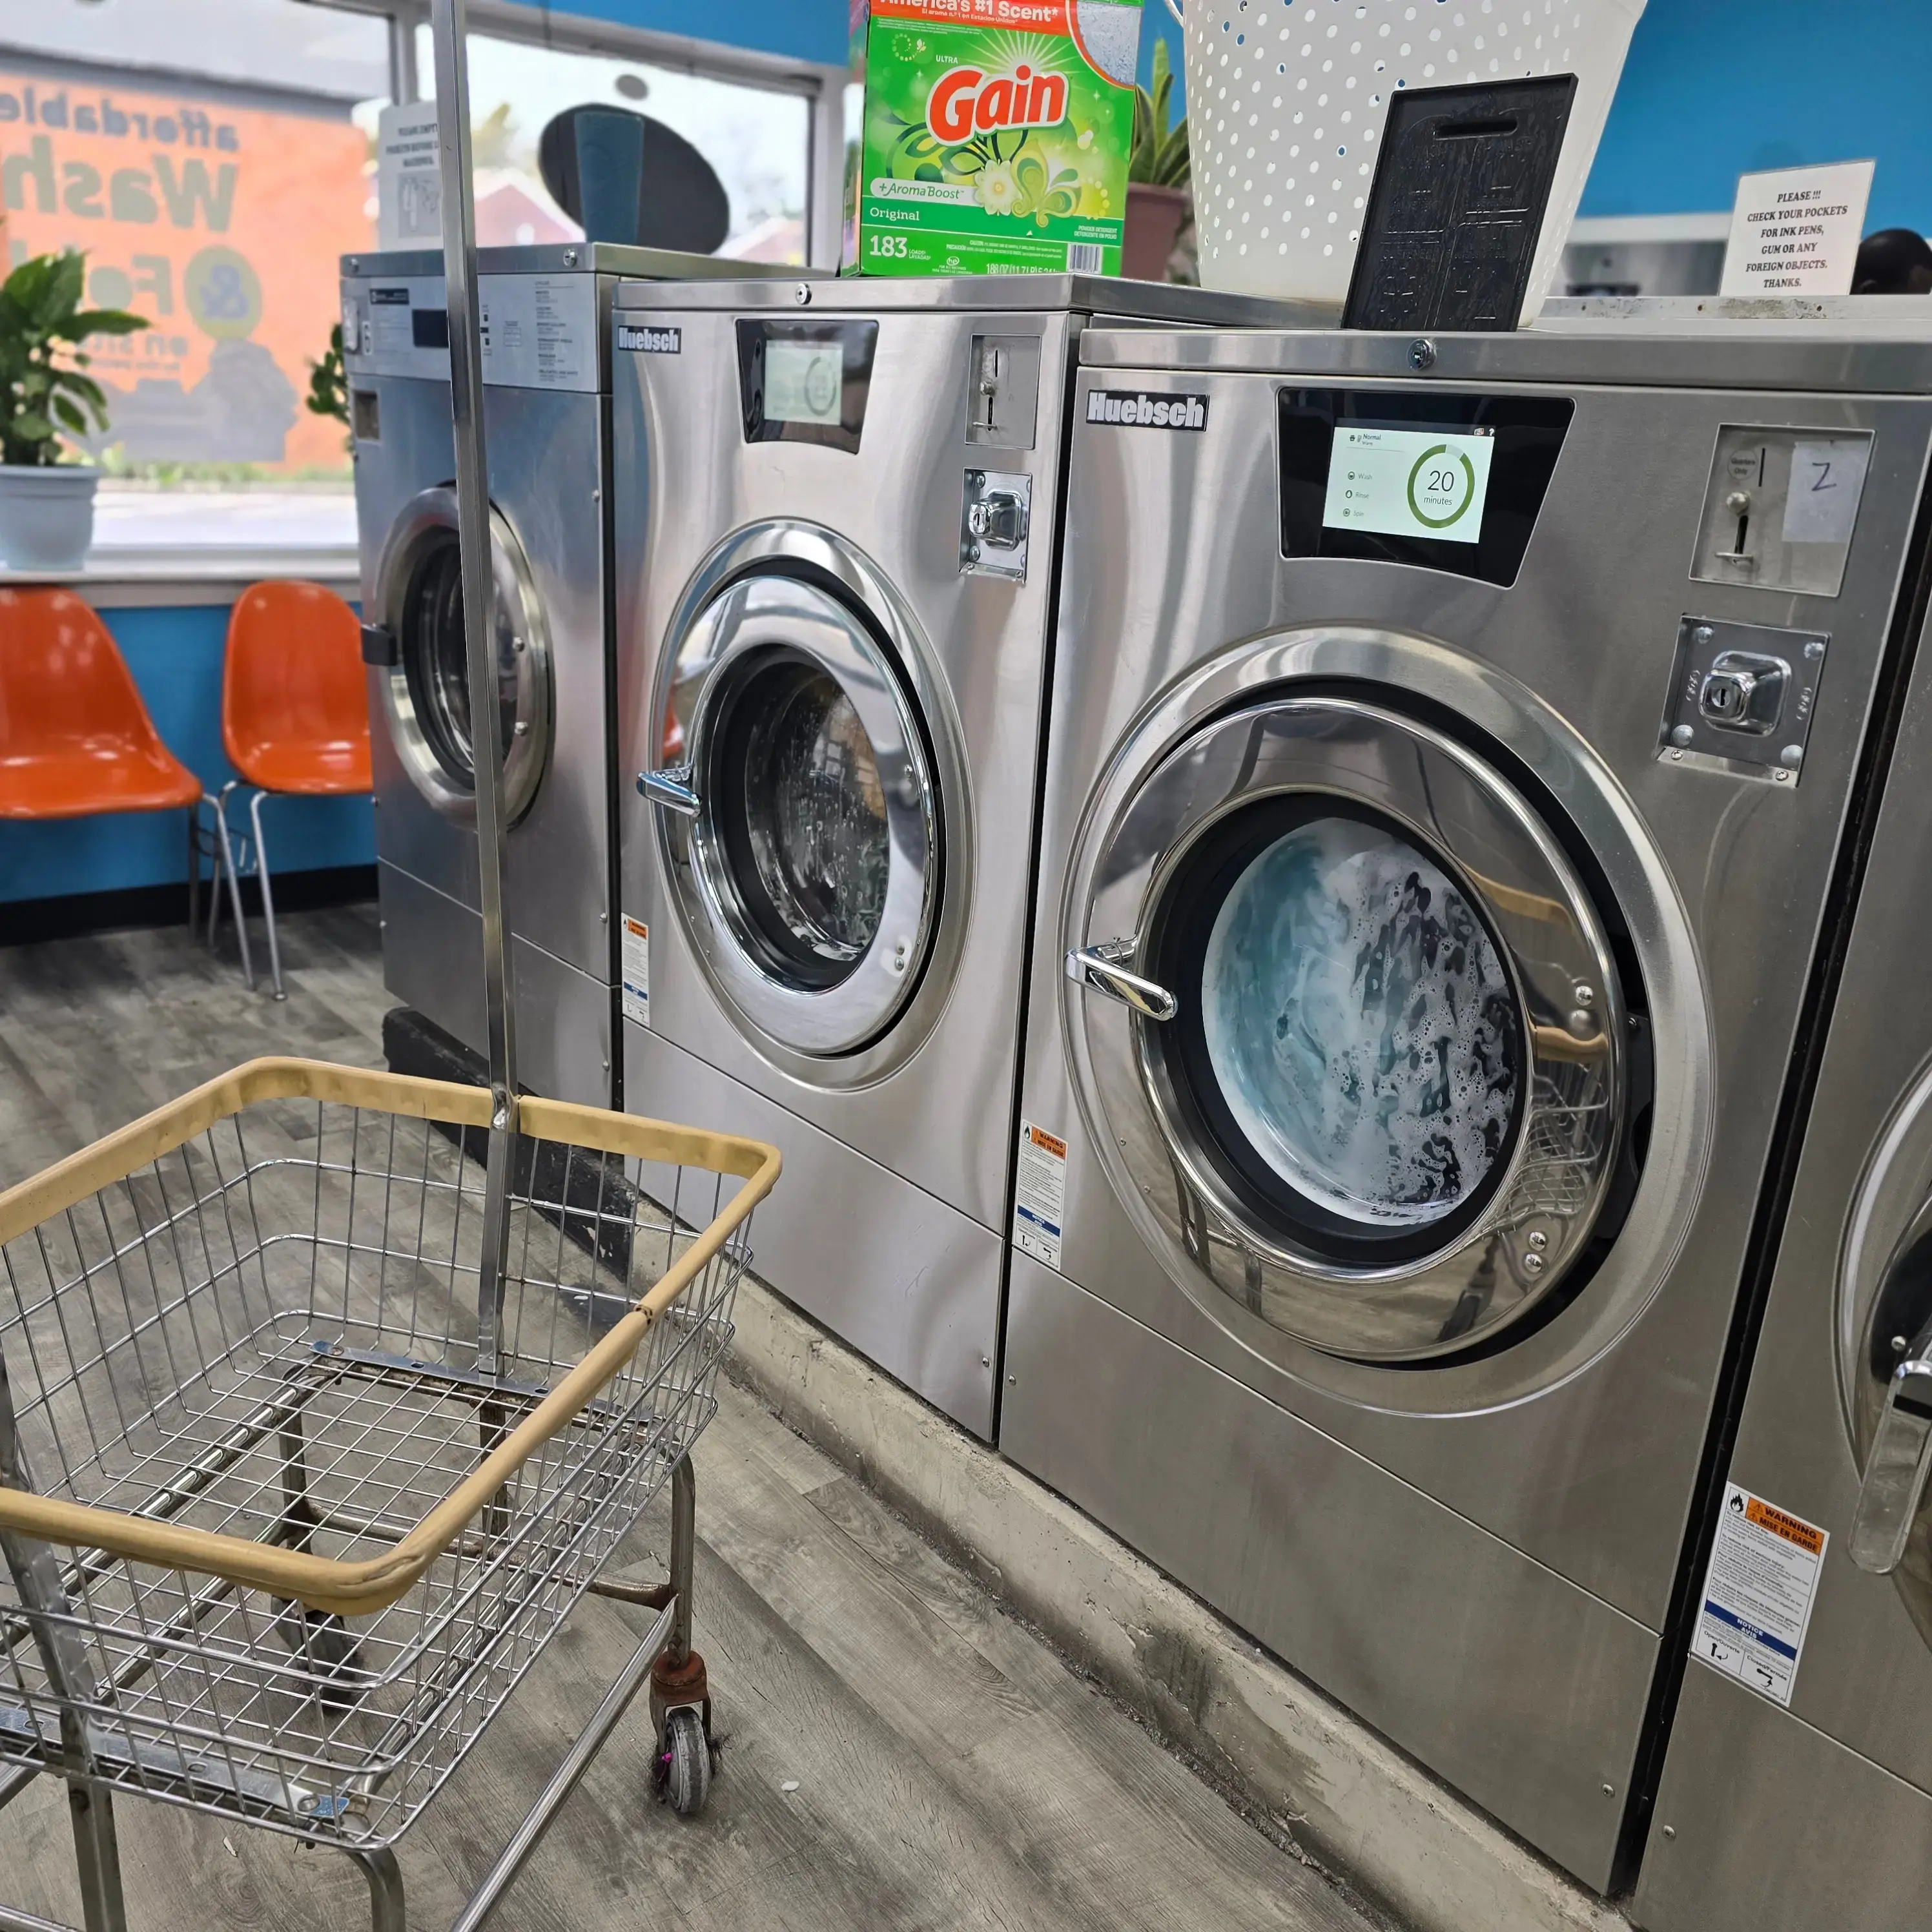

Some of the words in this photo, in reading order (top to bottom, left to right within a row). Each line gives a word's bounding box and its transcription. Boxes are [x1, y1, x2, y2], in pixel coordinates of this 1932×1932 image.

[881, 0, 971, 12] erica's
[974, 0, 993, 15] #1
[936, 54, 958, 64] ULTRA
[928, 65, 1065, 142] Gain
[1777, 191, 1811, 203] PLEASE
[1812, 190, 1822, 199] !!!
[870, 207, 920, 221] Original
[1747, 211, 1776, 222] CHECK
[1778, 209, 1803, 220] YOUR
[1804, 205, 1848, 218] POCKETS
[1761, 228, 1778, 238] FOR
[1779, 226, 1796, 237] INK
[1798, 225, 1824, 236] PENS,
[869, 235, 907, 258] 183
[1762, 244, 1781, 254] GUM
[1782, 243, 1794, 253] OR
[1796, 242, 1818, 252] ANY
[1745, 262, 1785, 272] FOREIGN
[1785, 260, 1827, 270] OBJECTS.
[1763, 278, 1802, 287] THANKS.
[619, 327, 679, 352] Huebsch
[1087, 391, 1204, 427] Huebsch
[1427, 470, 1455, 492] 20
[1423, 496, 1452, 506] minutes
[1763, 1506, 1817, 1540] WARNING
[1758, 1516, 1778, 1532] MISE
[1779, 1526, 1791, 1539] EN
[1791, 1532, 1818, 1553] GARDE
[1736, 1617, 1763, 1637] NOTICE
[1740, 1625, 1758, 1639] AVIS
